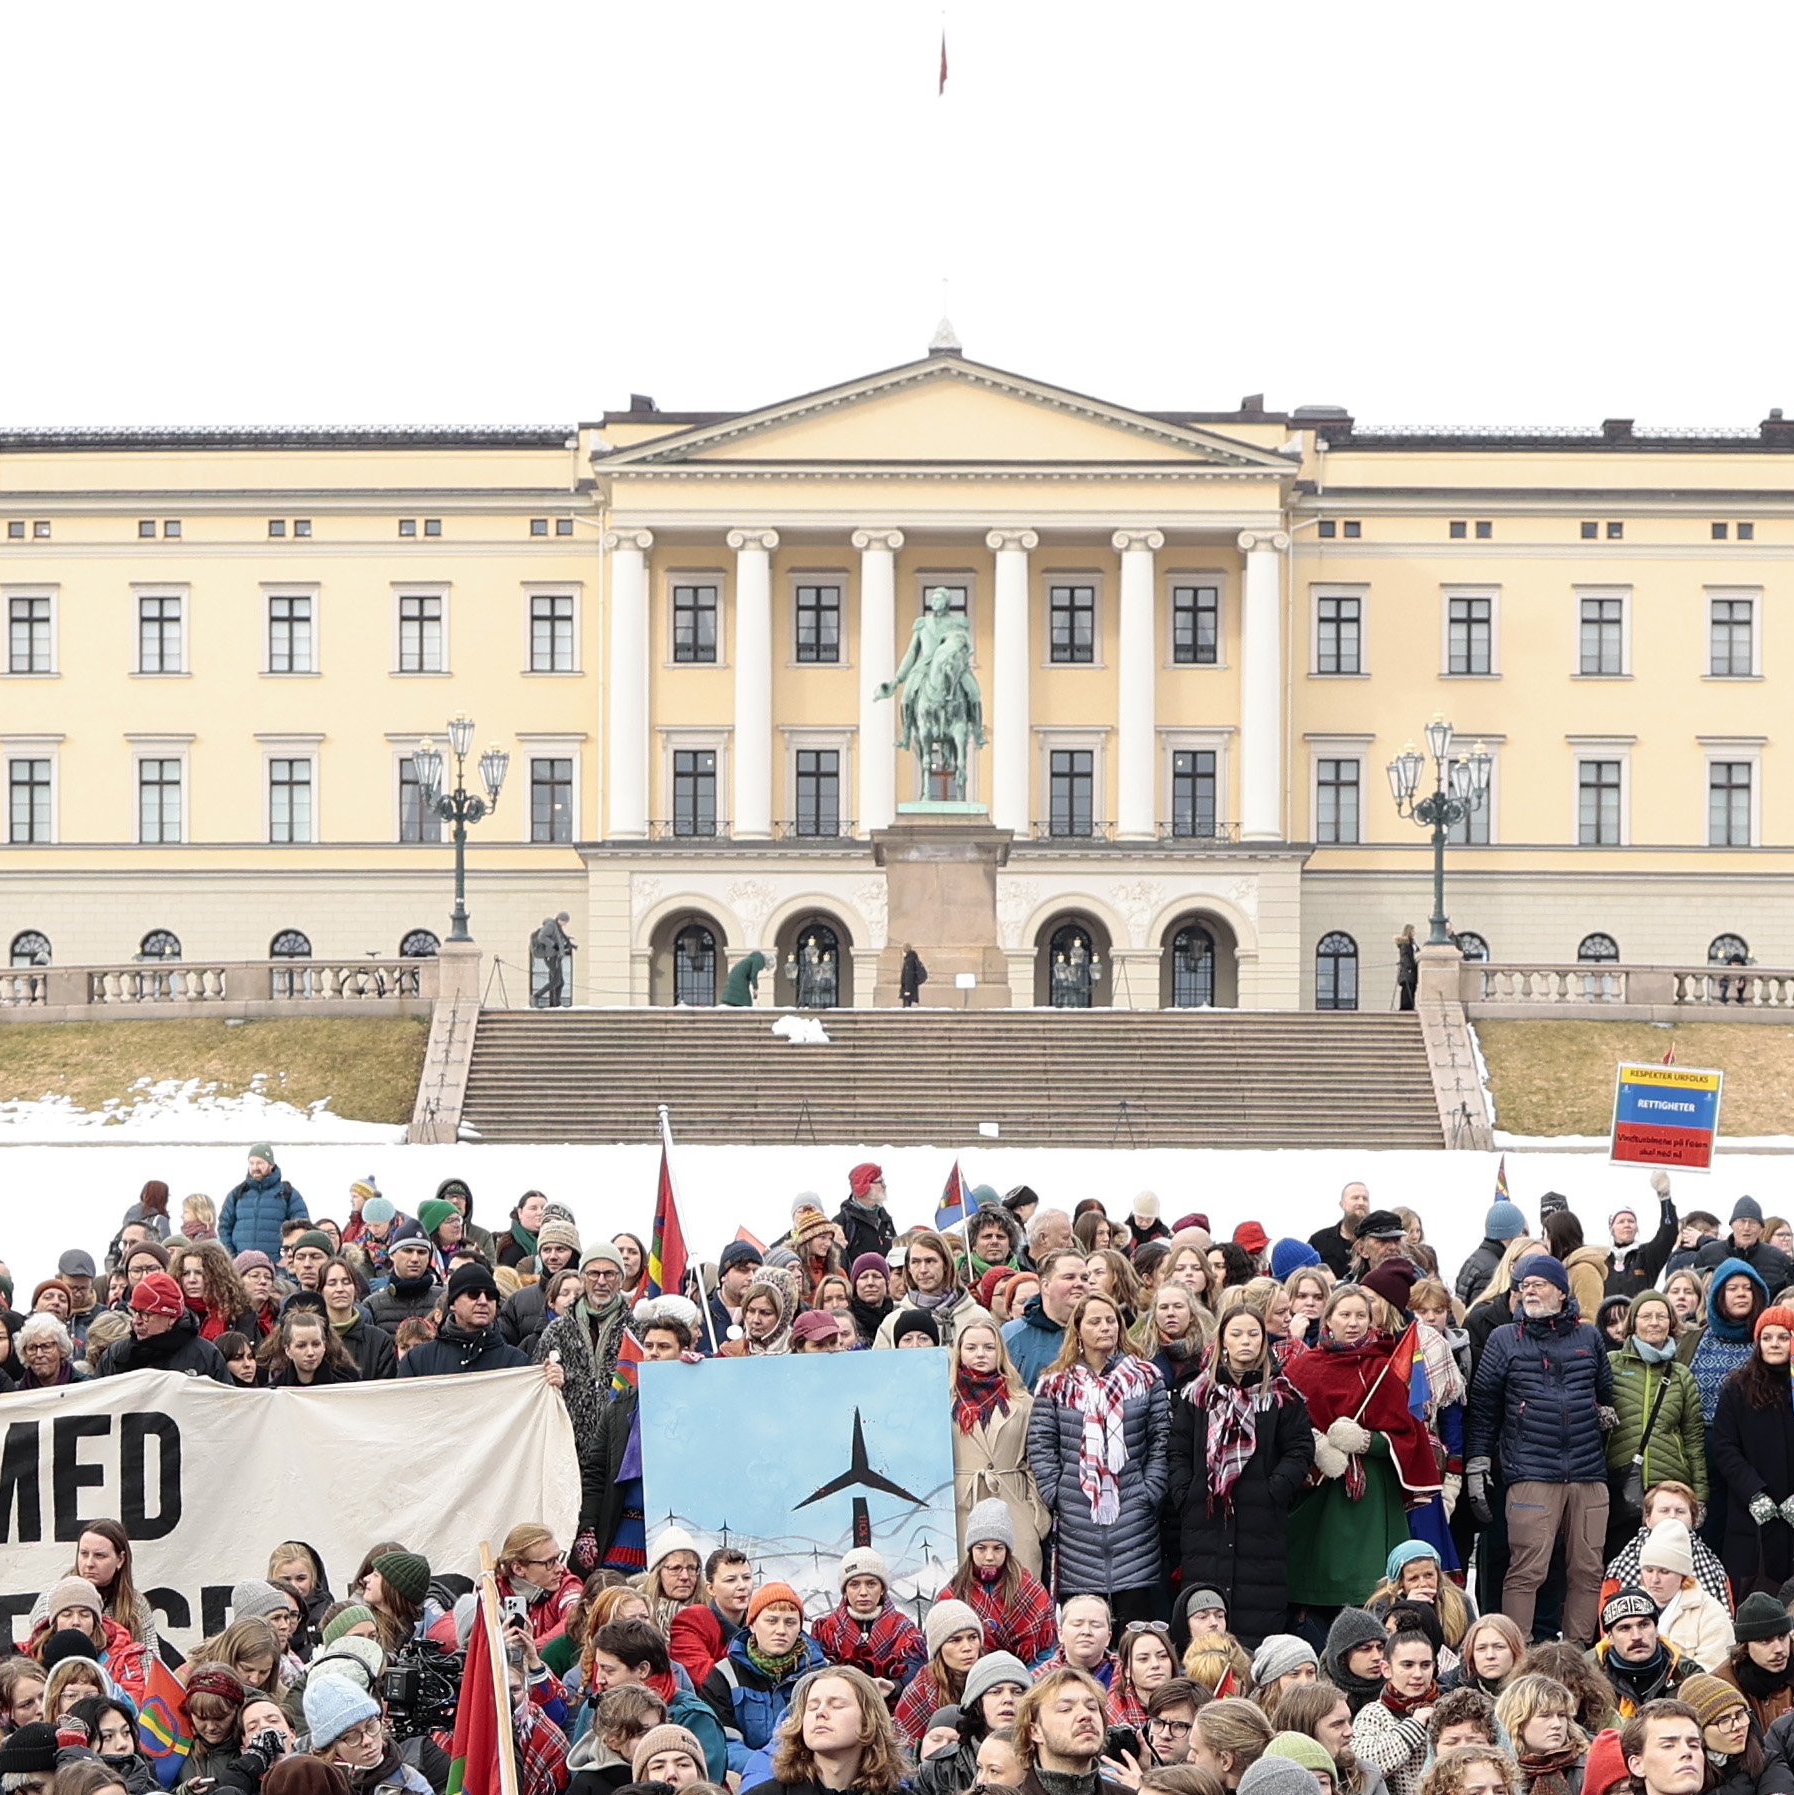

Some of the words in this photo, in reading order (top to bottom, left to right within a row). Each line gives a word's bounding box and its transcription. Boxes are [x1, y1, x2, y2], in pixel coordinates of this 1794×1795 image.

[1630, 1069, 1672, 1080] RESPEKTER
[1674, 1073, 1709, 1083] URFOLKS
[1637, 1098, 1696, 1112] RETTIGHETER
